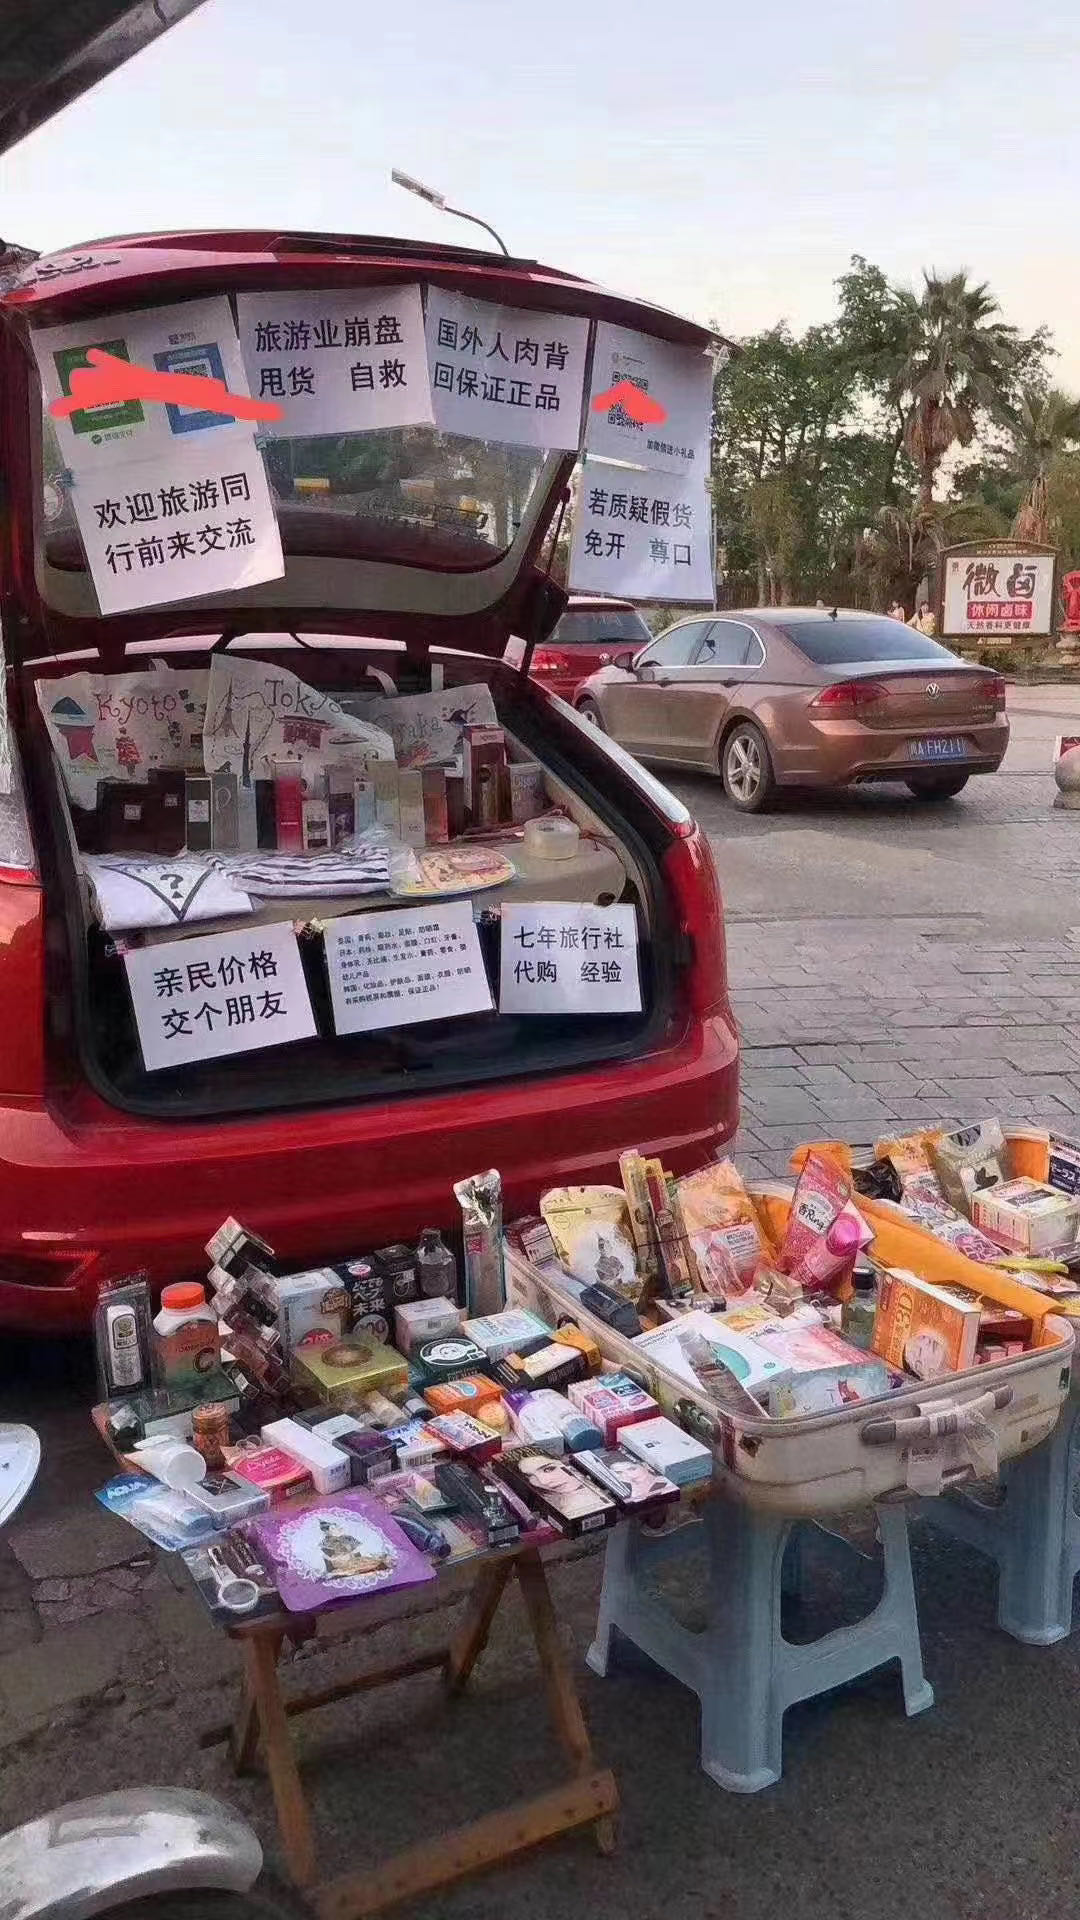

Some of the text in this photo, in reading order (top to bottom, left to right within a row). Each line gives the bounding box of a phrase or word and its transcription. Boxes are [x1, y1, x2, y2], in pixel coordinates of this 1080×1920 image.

[255, 314, 404, 352] 旅游业崩盘
[437, 318, 570, 371] 国外人肉背
[259, 357, 408, 398] 甩货 自救
[433, 362, 561, 412] 回保证正品
[94, 472, 252, 530] 欢迎旅游同
[587, 488, 692, 530] 若质疑假货
[105, 517, 256, 574] 行前来交流
[583, 531, 692, 566] 免开 尊口
[971, 603, 1028, 618] 休闲卤味
[93, 693, 177, 725] Kyoto
[265, 679, 342, 718] Tokyo
[514, 926, 624, 949] 七年旅行社
[154, 950, 278, 998] 亲民价格
[514, 960, 622, 983] 代购 经验
[161, 990, 288, 1040] 交个朋友
